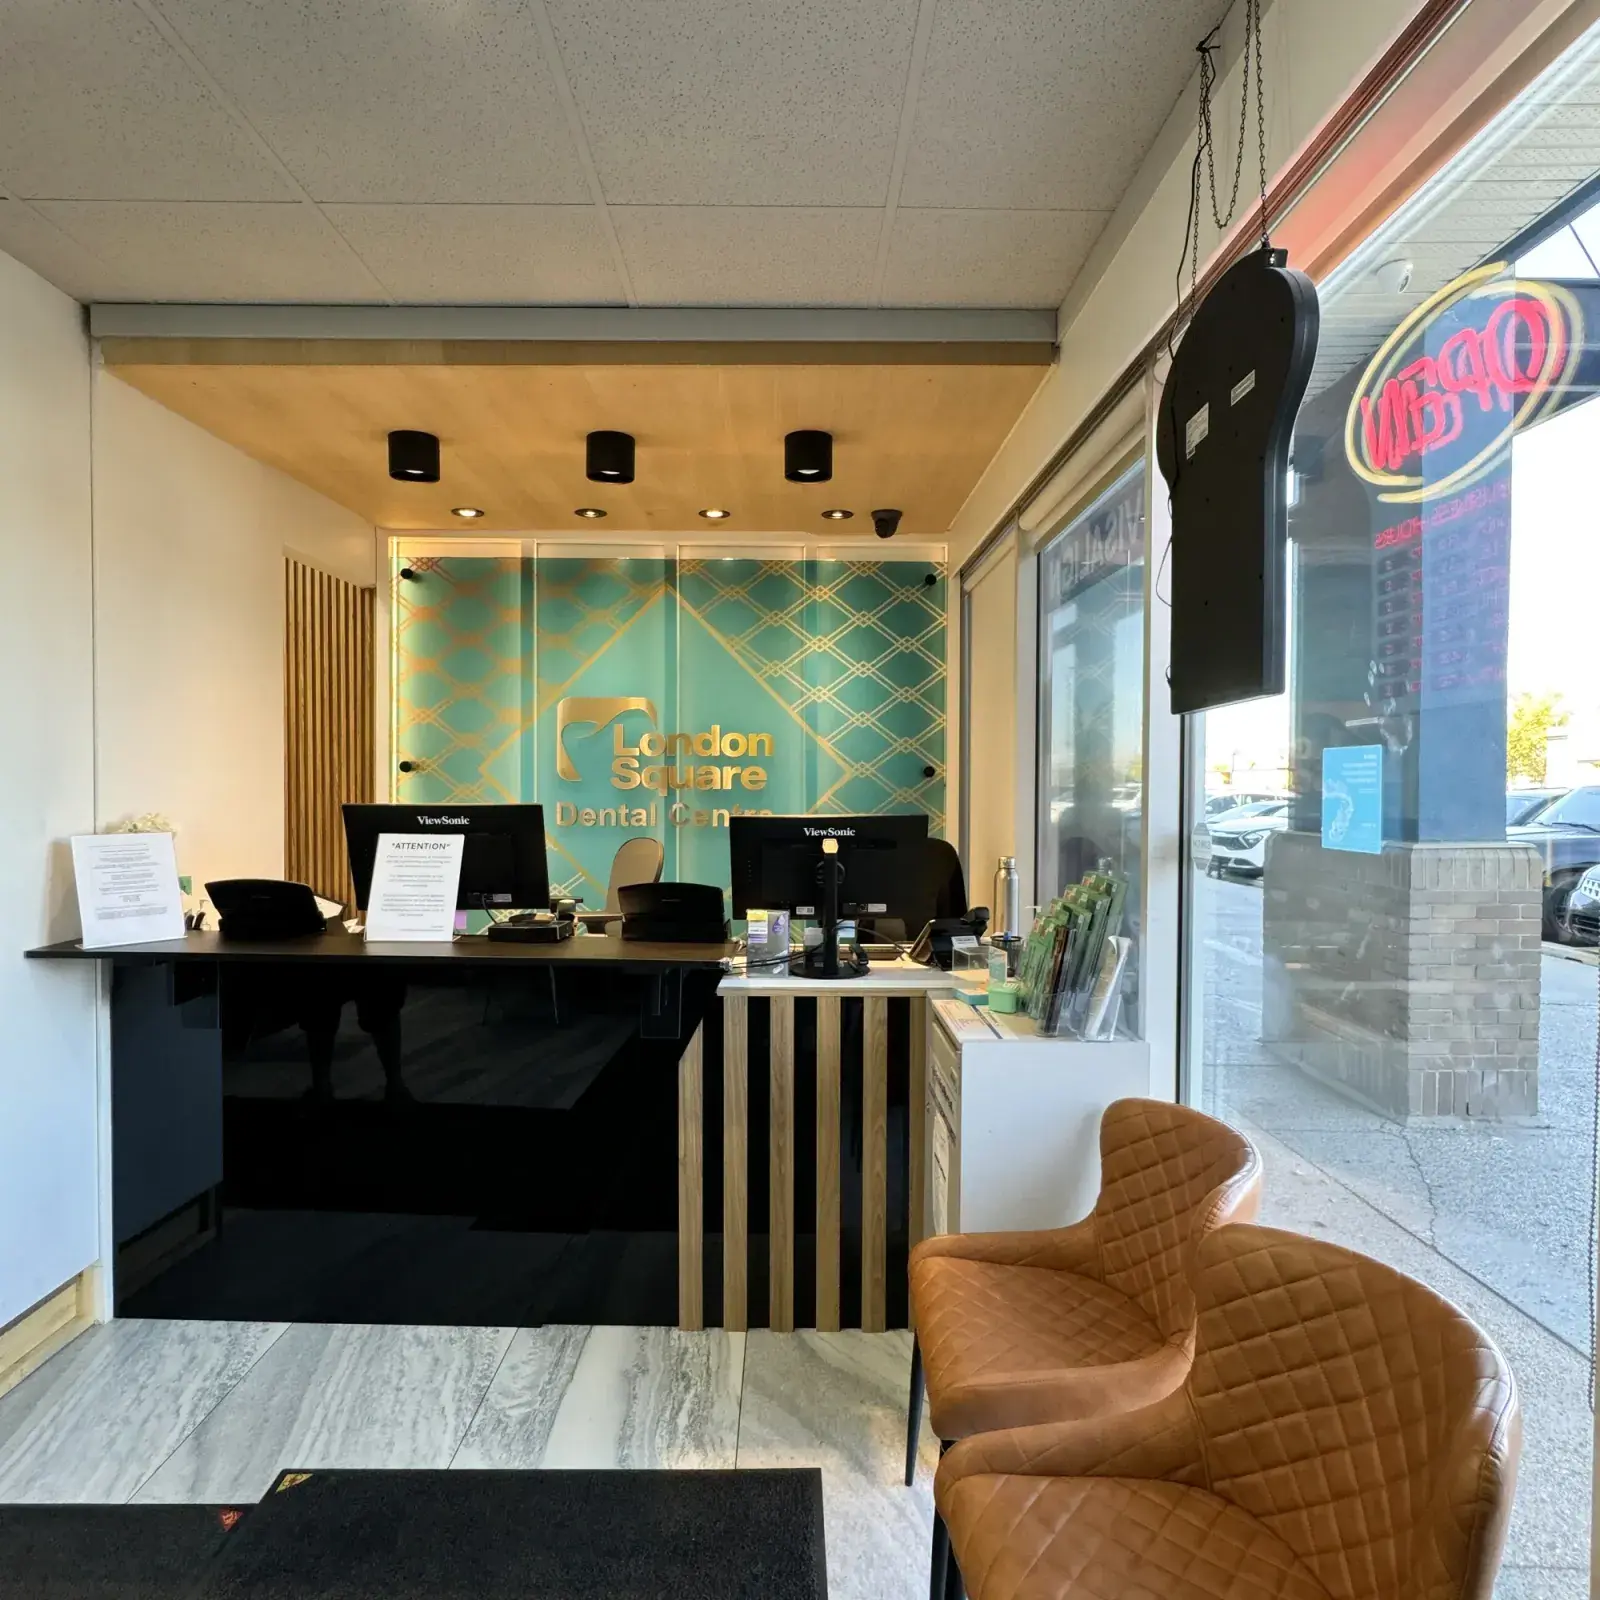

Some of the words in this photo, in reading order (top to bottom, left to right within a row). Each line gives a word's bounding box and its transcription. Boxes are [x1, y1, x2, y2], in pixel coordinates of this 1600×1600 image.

[613, 724, 774, 757] London
[611, 757, 768, 797] Square
[417, 815, 470, 825] ViewSonic
[556, 802, 657, 827] Dental
[803, 827, 856, 836] ViewSonic
